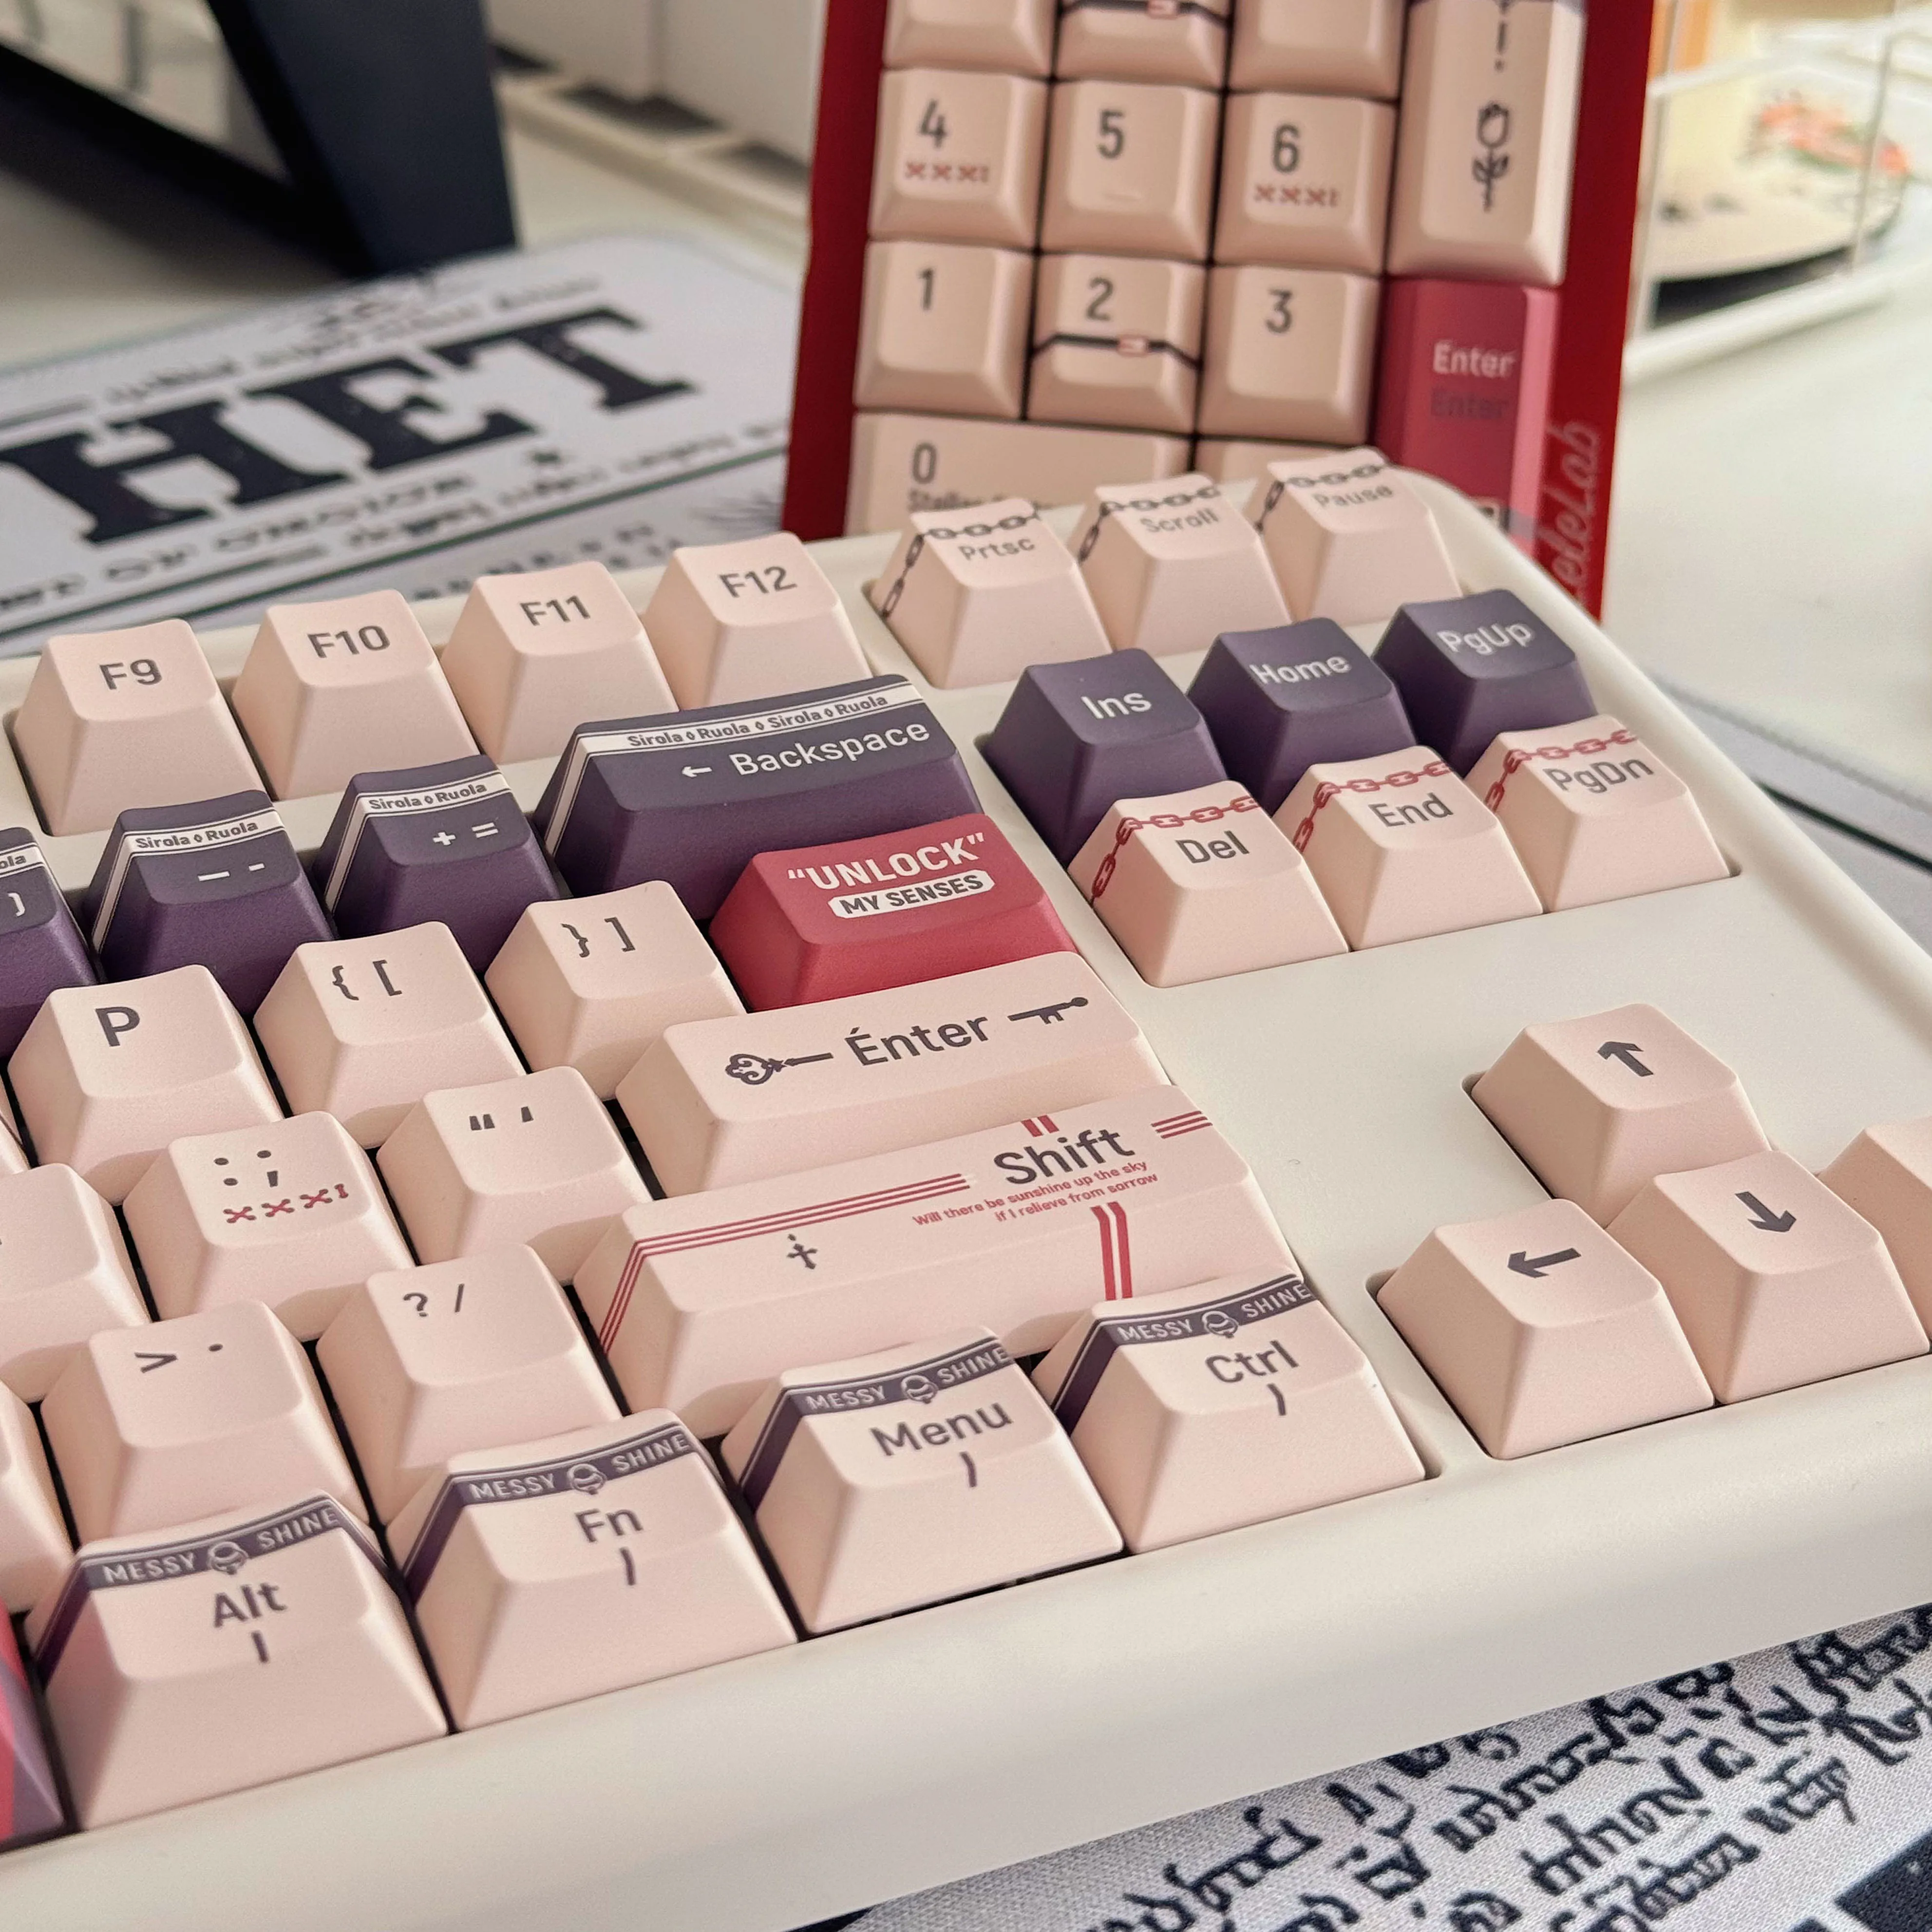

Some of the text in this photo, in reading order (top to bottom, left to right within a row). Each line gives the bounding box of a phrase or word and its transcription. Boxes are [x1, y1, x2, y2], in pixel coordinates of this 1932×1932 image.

[917, 99, 949, 149] 4
[1097, 109, 1126, 160] 5
[1272, 124, 1301, 173] 6
[917, 266, 936, 312] 1
[1085, 277, 1116, 322] 2
[1265, 289, 1293, 334] 3
[1433, 339, 1515, 379] Enter
[912, 442, 937, 485] 0
[1313, 484, 1393, 509] Pause
[1140, 508, 1219, 534] Scroll
[959, 536, 1036, 562] Prtsc
[719, 566, 797, 598] F12
[520, 596, 591, 626] F11
[307, 625, 390, 659] F10
[1438, 622, 1534, 656] PgUp
[99, 659, 163, 690] F9
[1250, 654, 1351, 685] Home
[628, 696, 888, 747] Sirola Ruola Sirola Ruola
[1080, 690, 1153, 720] Ins
[729, 723, 930, 777] Backspace
[368, 782, 488, 811] Sirola Ruola
[1543, 758, 1654, 795] PgDn
[1368, 793, 1453, 828] End
[135, 820, 259, 850] Sirola Ruola
[1175, 831, 1250, 864] Del
[840, 874, 984, 915] MY SENSES
[561, 917, 636, 958] } ]
[332, 959, 402, 1002] { [
[95, 1005, 141, 1047] P
[845, 1016, 988, 1066] Énter
[993, 1128, 1136, 1185] Shift
[912, 1159, 1148, 1226] Will there be sunshine up the sky
[1018, 1196, 1067, 1218] relieve
[1068, 1187, 1106, 1203] from
[1107, 1172, 1159, 1193] sorrow
[402, 1292, 429, 1318] ?
[1117, 1283, 1313, 1343] MESSY SHINE
[805, 1345, 1012, 1412] MESSY SHINE
[1205, 1339, 1300, 1384] Ctrl
[870, 1402, 1015, 1458] Menu
[469, 1433, 691, 1501] MESSY SHINE
[103, 1509, 341, 1584] MESSY SHINE
[575, 1507, 644, 1544] Fn
[212, 1581, 288, 1629] Alt
